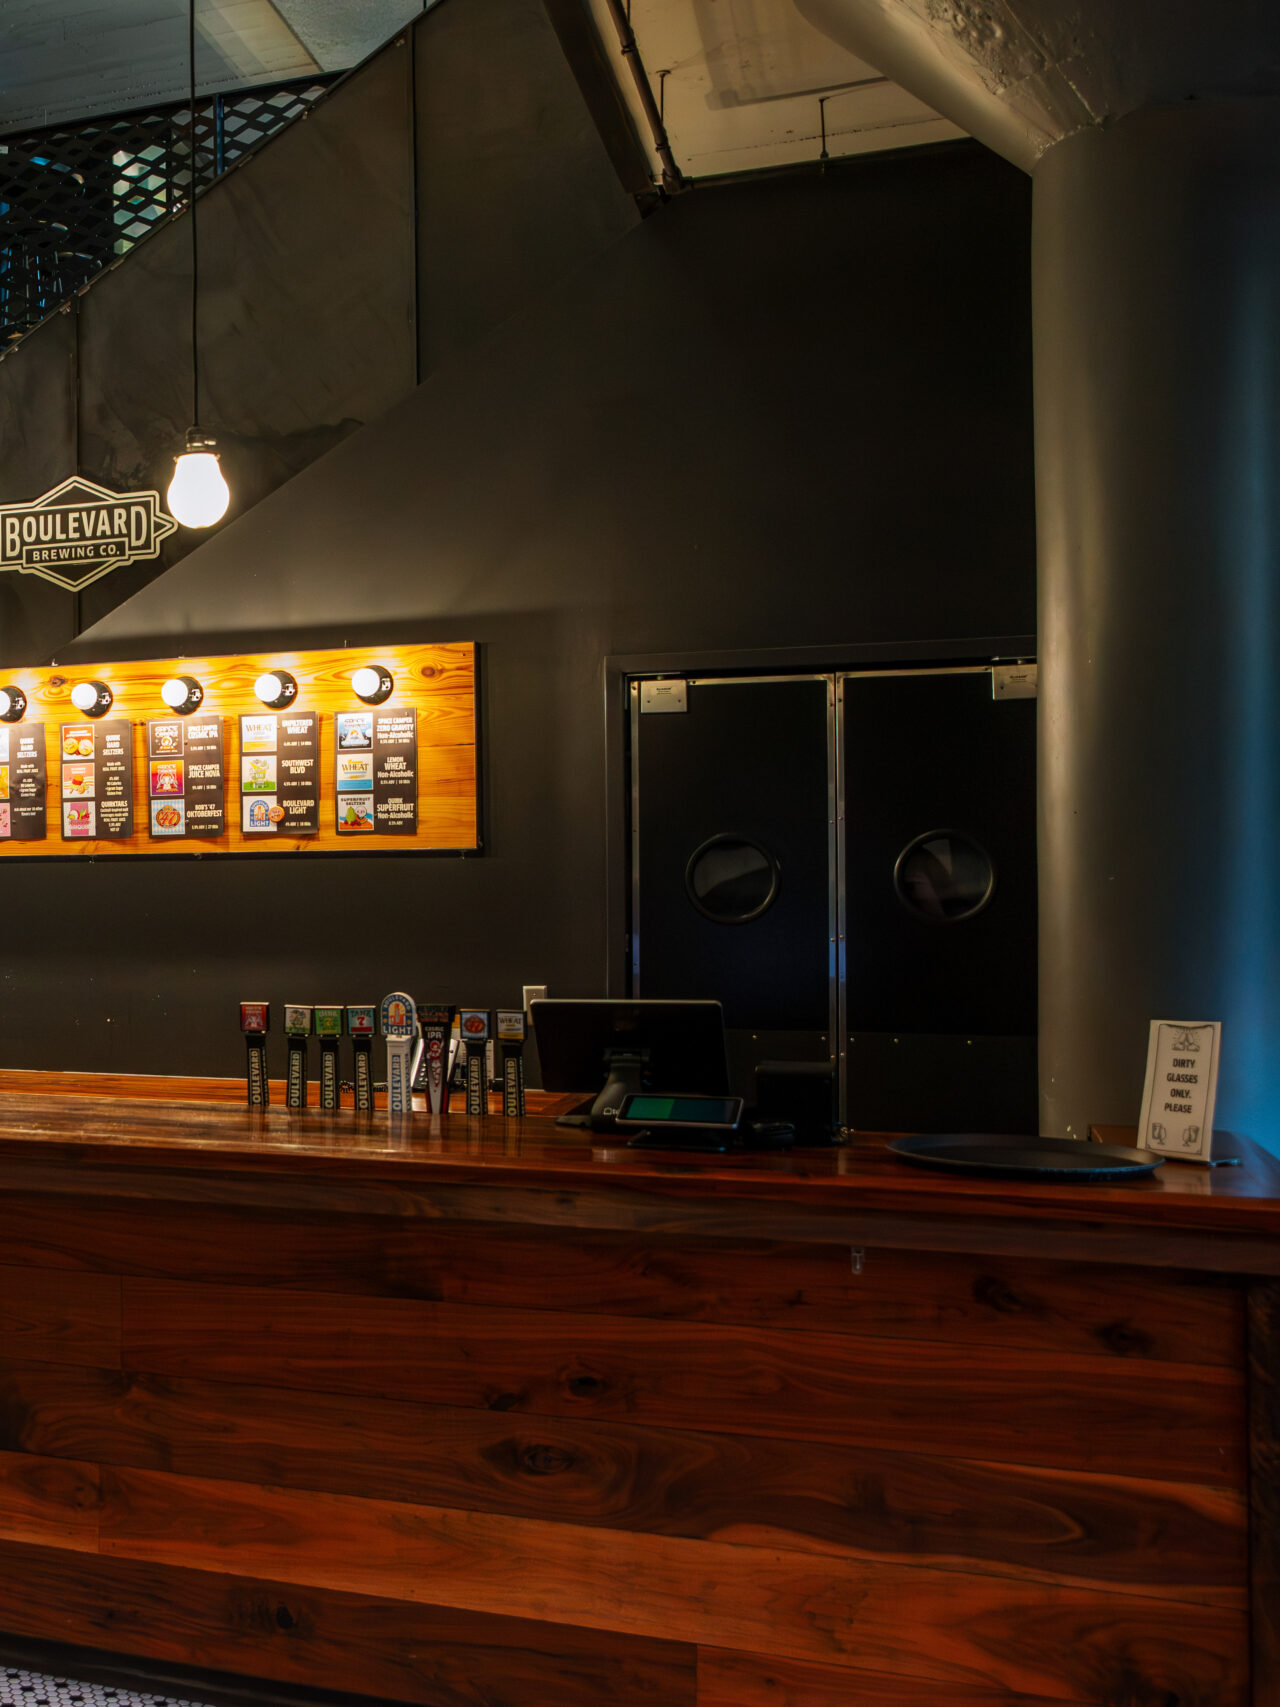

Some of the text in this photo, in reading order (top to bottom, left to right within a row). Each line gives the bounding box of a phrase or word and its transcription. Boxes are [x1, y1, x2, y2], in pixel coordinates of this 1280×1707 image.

[6, 506, 148, 558] BOULEVARD
[32, 544, 120, 561] BREWING CO.
[245, 724, 272, 732] WHEAT
[391, 724, 414, 732] GRAVITY
[377, 731, 413, 739] Non-Alcoholic
[282, 759, 314, 767] SOUTHWEST
[384, 762, 406, 770] WHEAT
[188, 770, 204, 778] JUICE
[290, 766, 305, 774] BLVD
[378, 770, 414, 778] Non-Alcoholic
[377, 803, 414, 811] SUPERFRUIT
[186, 810, 222, 818] OKTOBERFEST
[357, 1017, 365, 1026] 7
[383, 1026, 411, 1034] LIGHT
[1172, 1058, 1195, 1068] DIRTY
[251, 1050, 260, 1103] OULEVARD
[290, 1053, 300, 1106] OULEVARD
[325, 1054, 334, 1108] OULEVARD
[359, 1054, 368, 1108] OULEVARD
[1166, 1073, 1198, 1084] GLASSES
[392, 1056, 402, 1111] OULEVARD
[508, 1060, 516, 1116] OULEVARD
[1170, 1088, 1192, 1099] ONLY.
[1164, 1102, 1192, 1113] PLEASE
